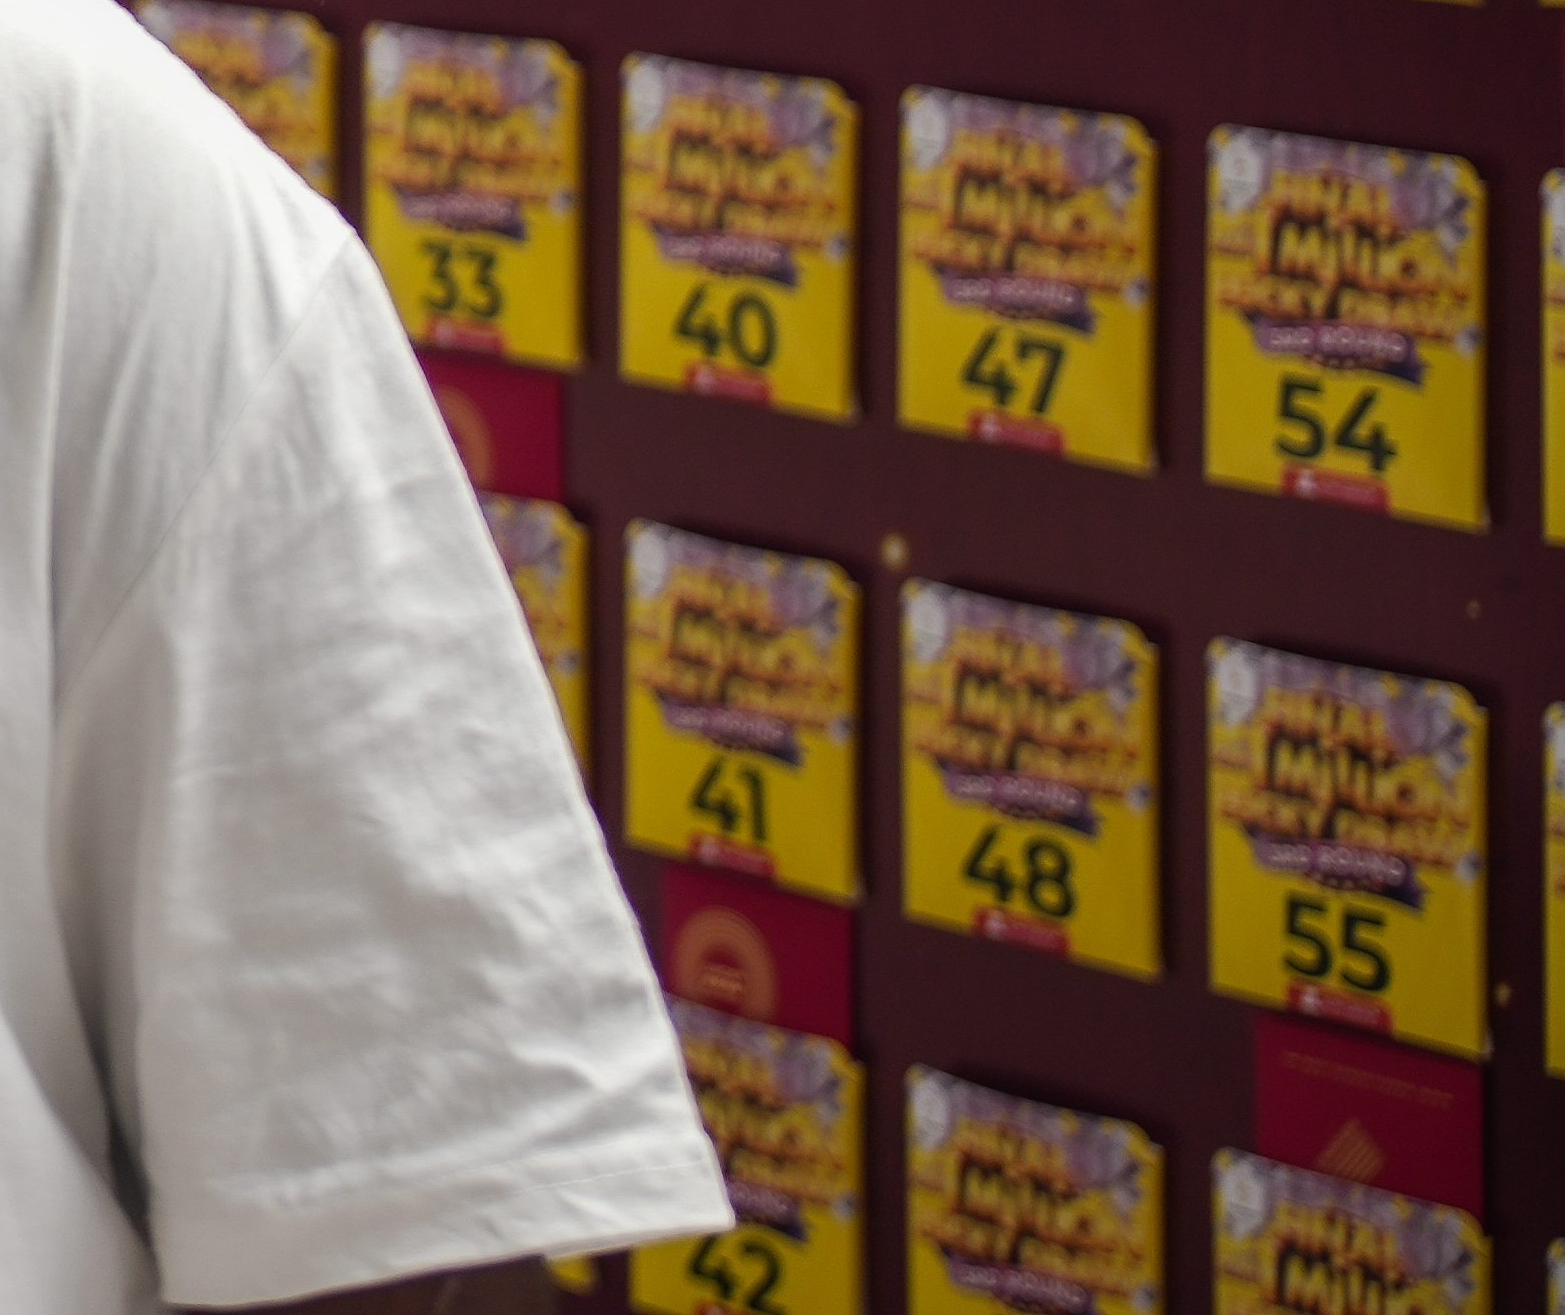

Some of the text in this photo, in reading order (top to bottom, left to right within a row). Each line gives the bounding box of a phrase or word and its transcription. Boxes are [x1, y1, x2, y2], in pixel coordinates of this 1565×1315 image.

[420, 239, 504, 321] 33
[674, 283, 779, 369] 40
[961, 327, 1067, 414] 47
[1274, 376, 1398, 472] 54
[689, 755, 766, 843] 41
[964, 823, 1078, 922] 48
[1284, 894, 1395, 997] 55
[686, 1234, 785, 1315] 42
